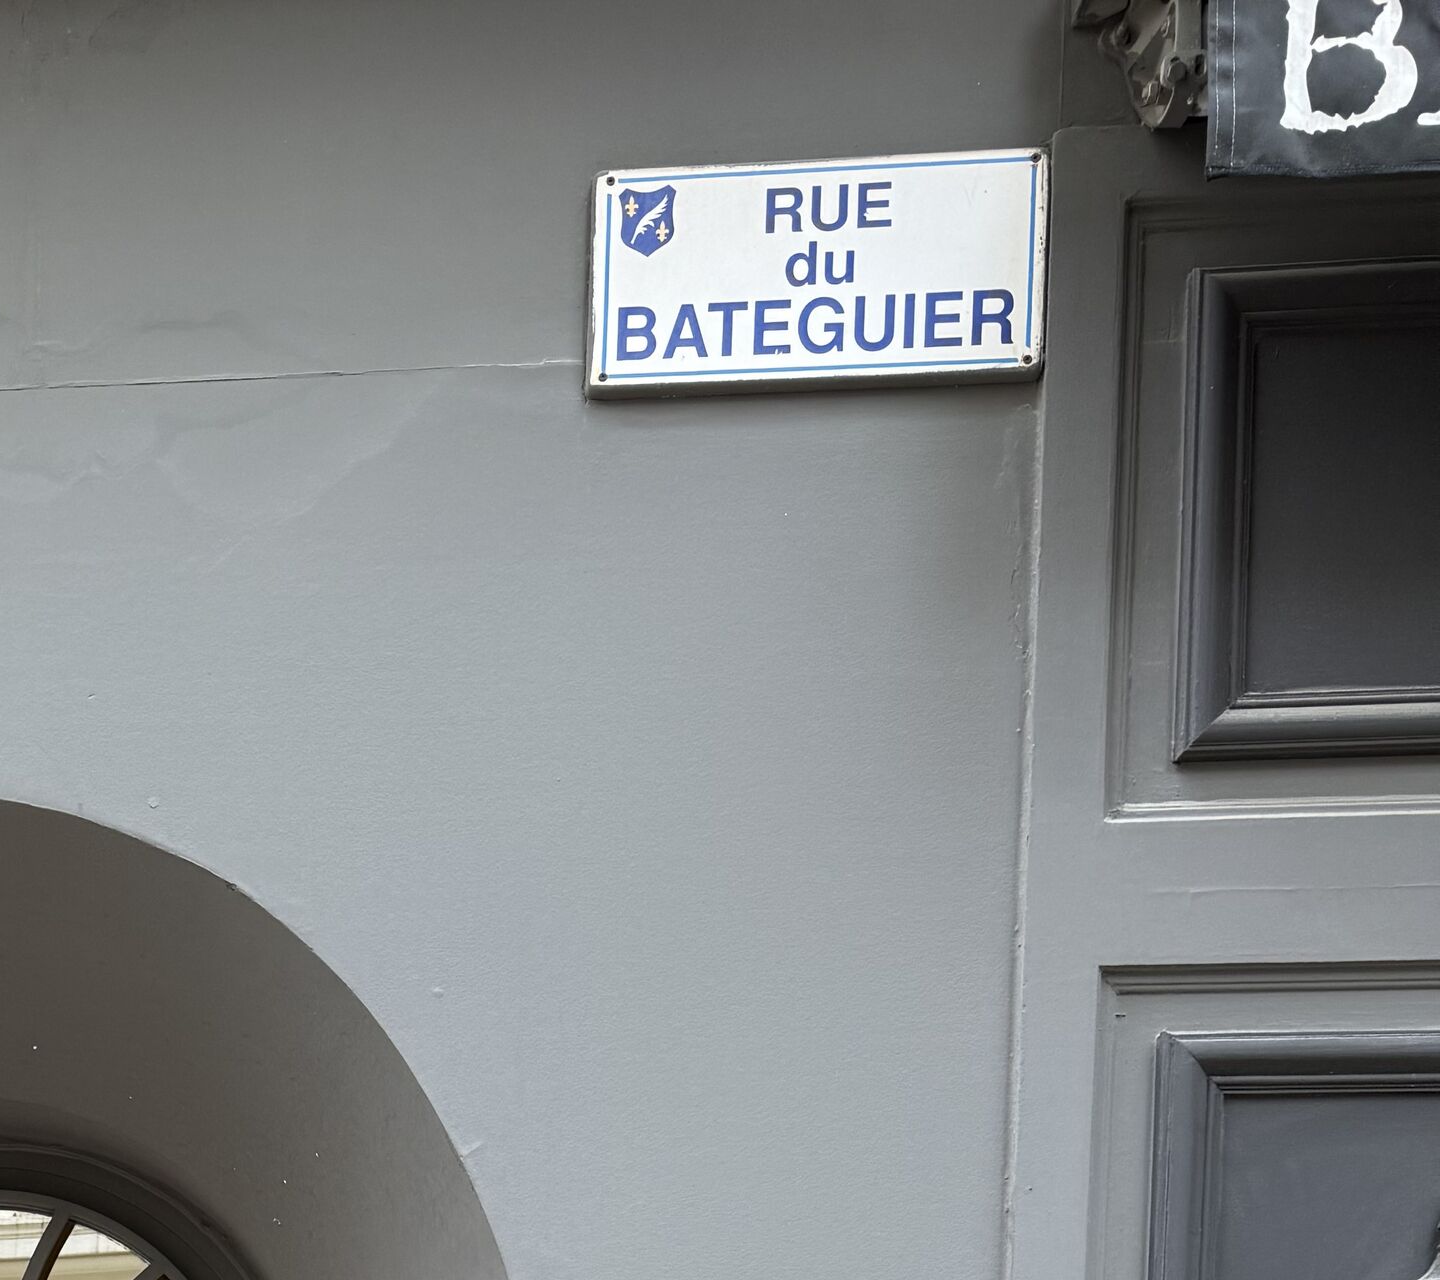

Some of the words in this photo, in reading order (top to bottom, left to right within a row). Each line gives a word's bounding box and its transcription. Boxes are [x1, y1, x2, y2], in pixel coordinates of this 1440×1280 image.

[1279, 0, 1440, 135] B
[764, 180, 893, 235] RUE
[784, 241, 856, 288] du
[616, 289, 1016, 362] BATEGUIER
